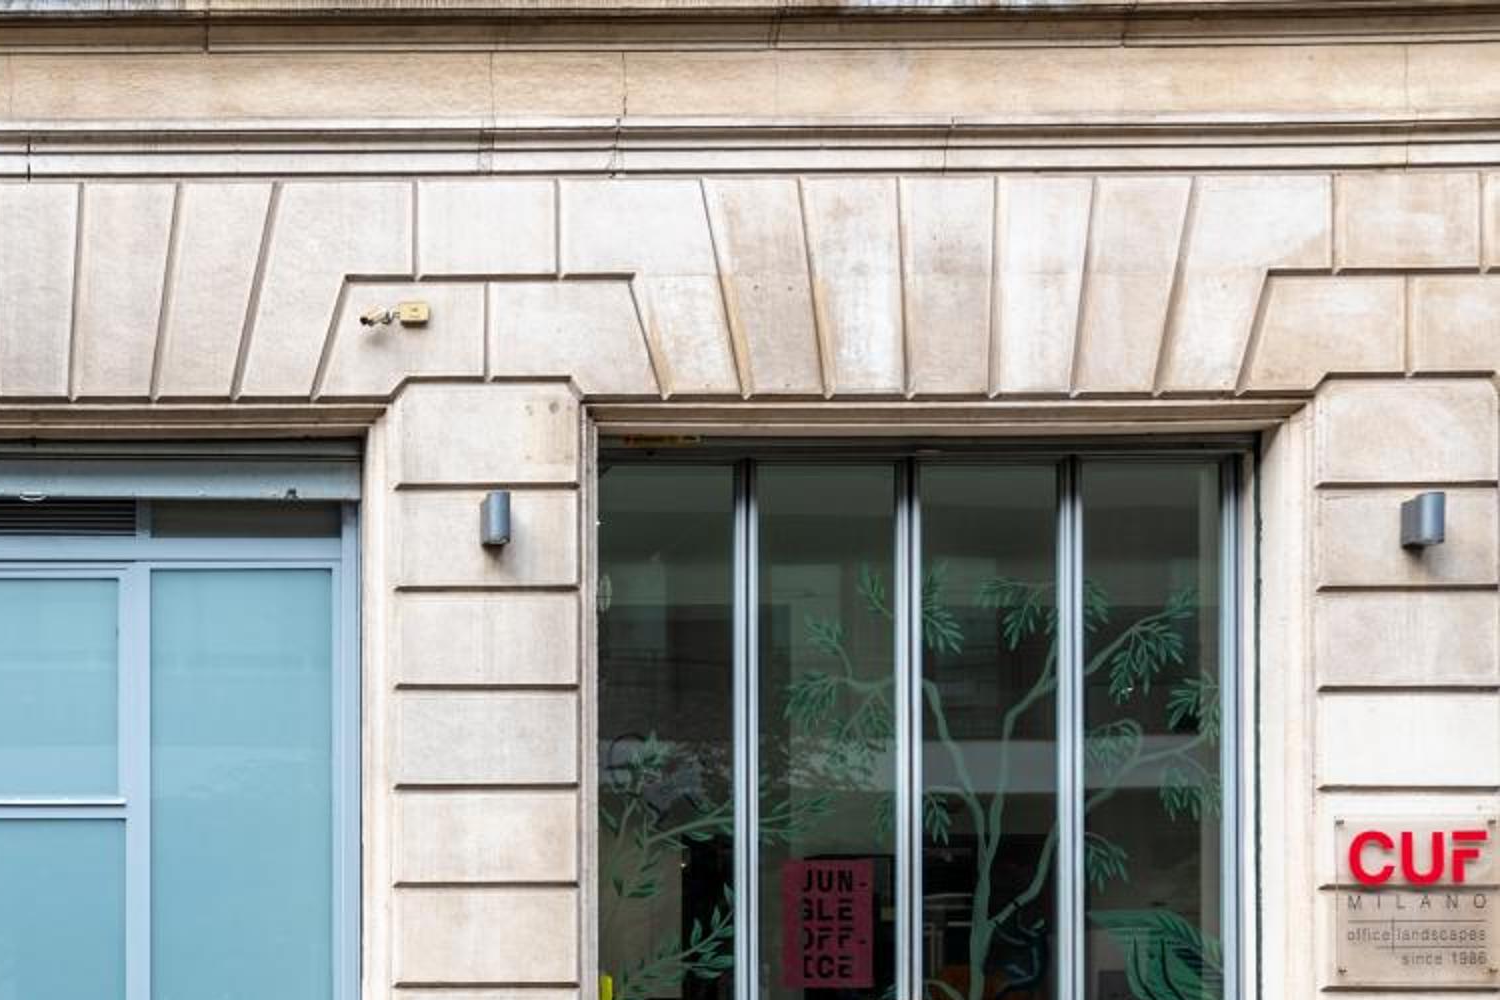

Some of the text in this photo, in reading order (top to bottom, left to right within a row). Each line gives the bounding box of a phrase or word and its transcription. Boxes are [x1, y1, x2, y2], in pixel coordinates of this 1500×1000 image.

[1349, 830, 1488, 886] CUF
[1348, 894, 1488, 909] MILANO
[1402, 952, 1443, 966] since
